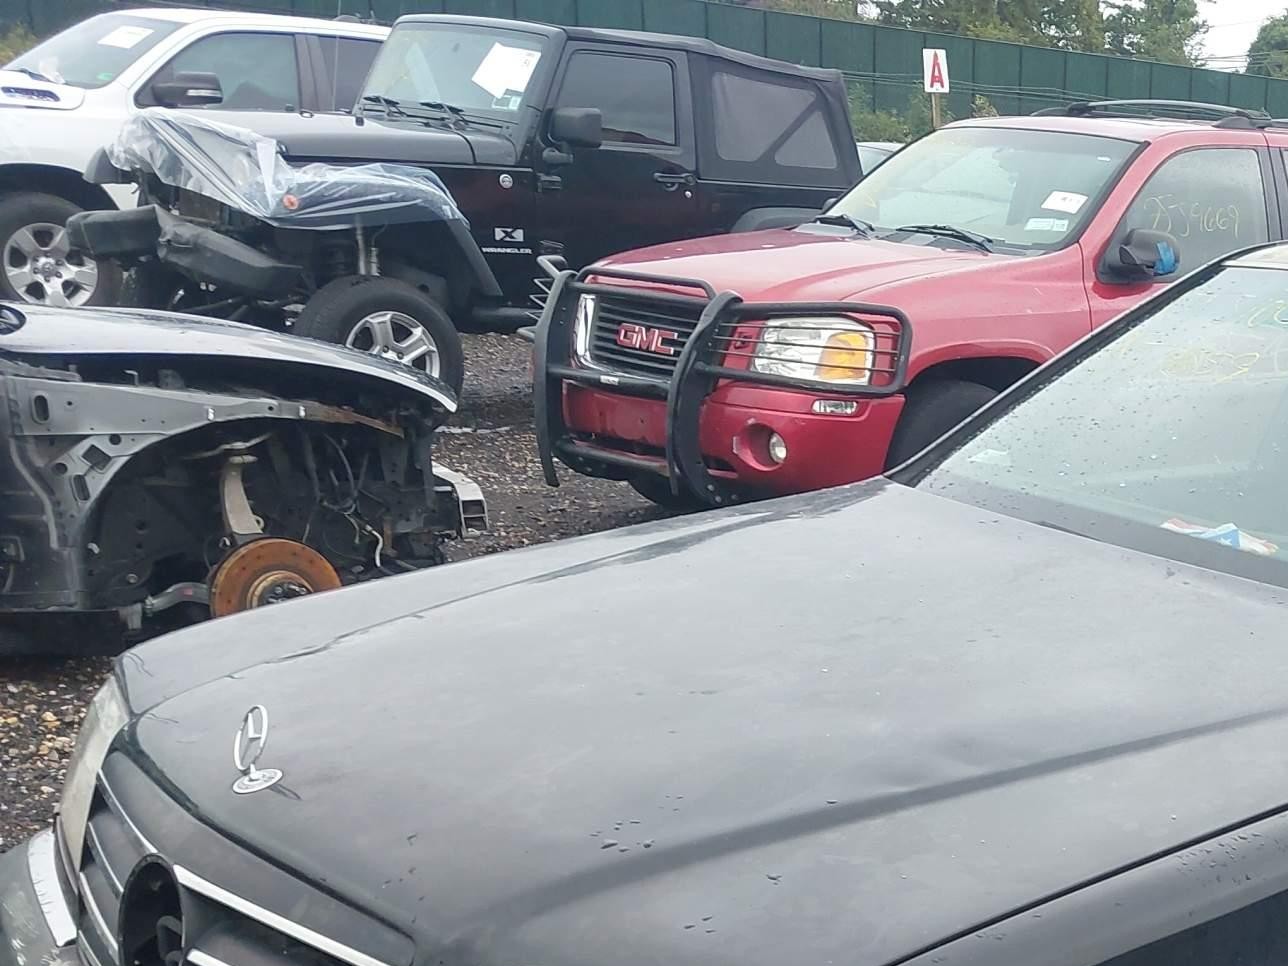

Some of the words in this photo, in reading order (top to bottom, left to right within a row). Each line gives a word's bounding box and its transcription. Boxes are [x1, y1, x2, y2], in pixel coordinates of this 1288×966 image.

[930, 50, 945, 88] A
[481, 246, 533, 255] WRANGLER
[616, 322, 678, 355] GMC
